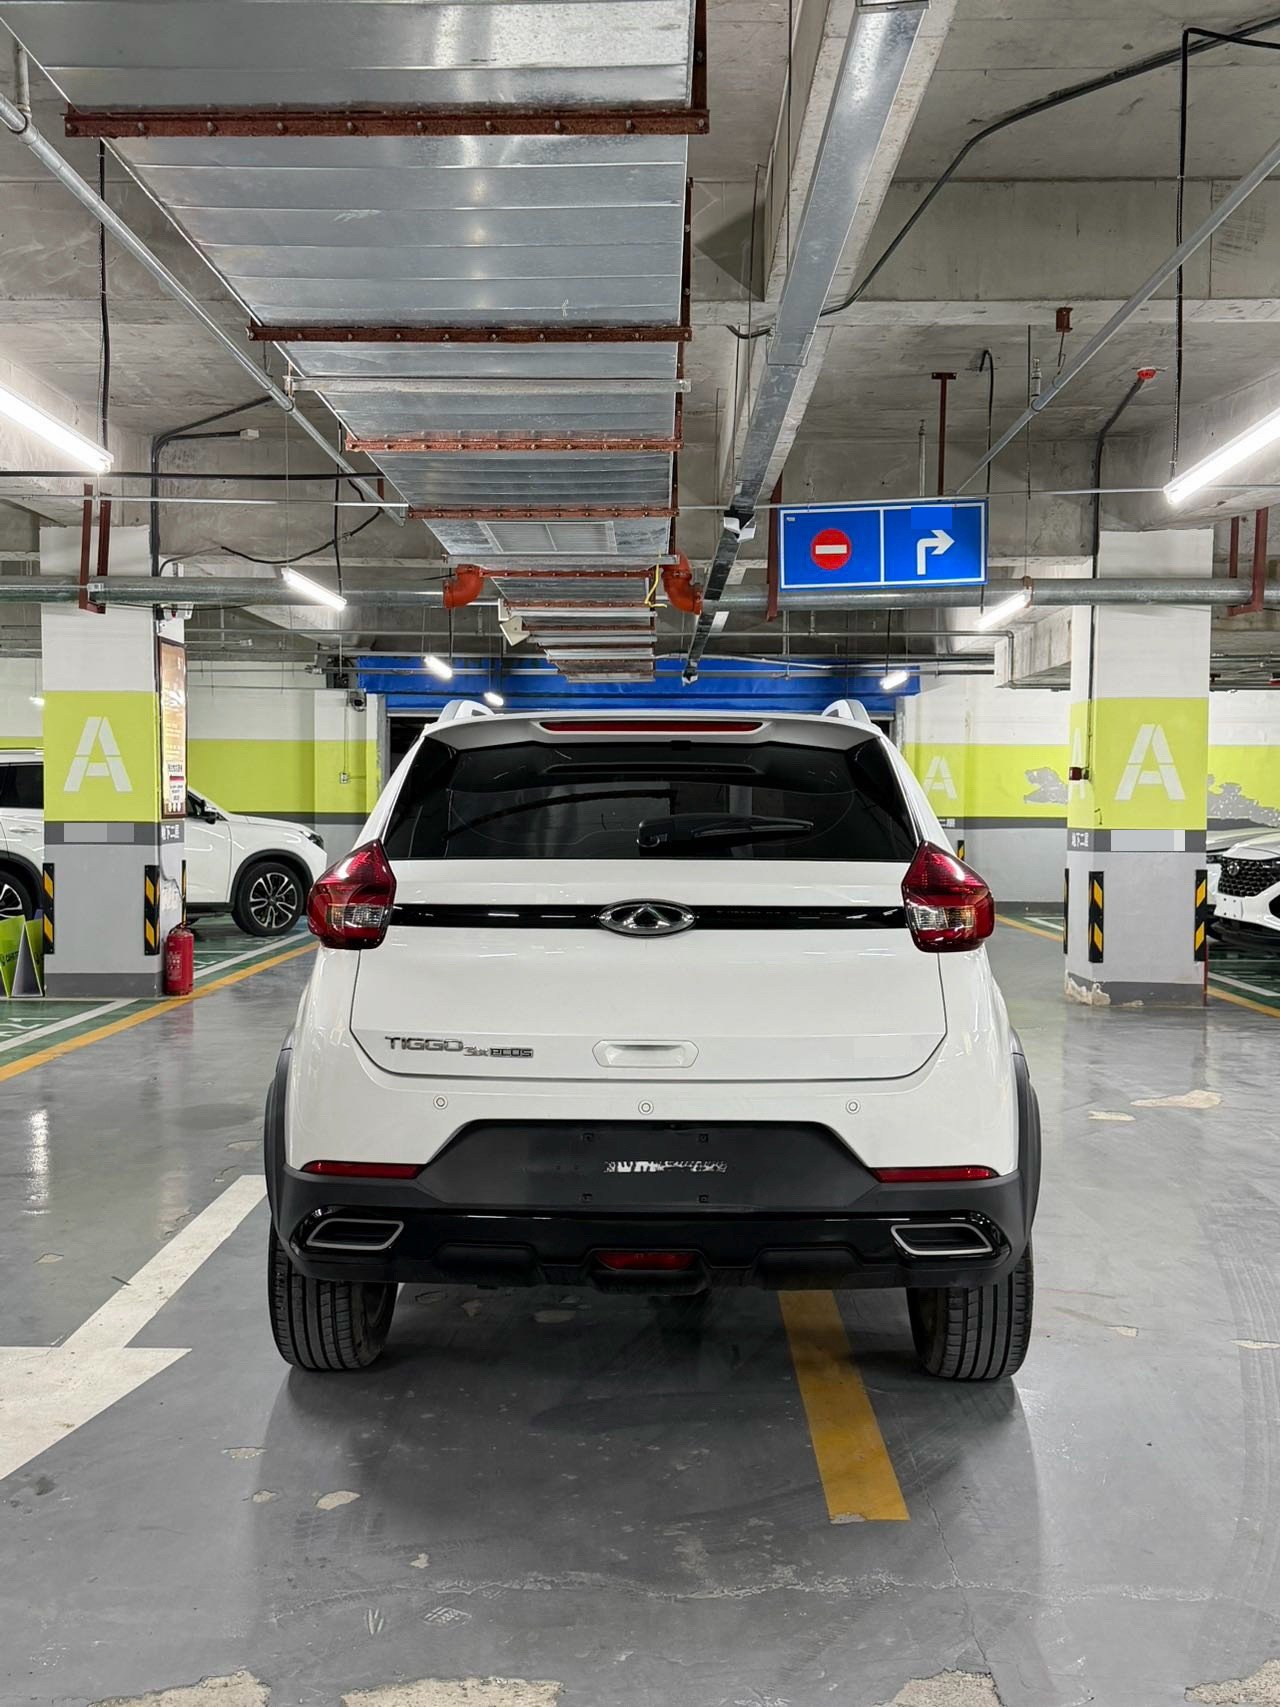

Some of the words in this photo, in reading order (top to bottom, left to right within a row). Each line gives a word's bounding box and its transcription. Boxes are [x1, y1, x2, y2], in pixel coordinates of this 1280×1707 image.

[63, 715, 134, 793] A
[922, 754, 958, 801] A
[1114, 723, 1186, 802] A
[384, 1036, 464, 1052] TIGGO
